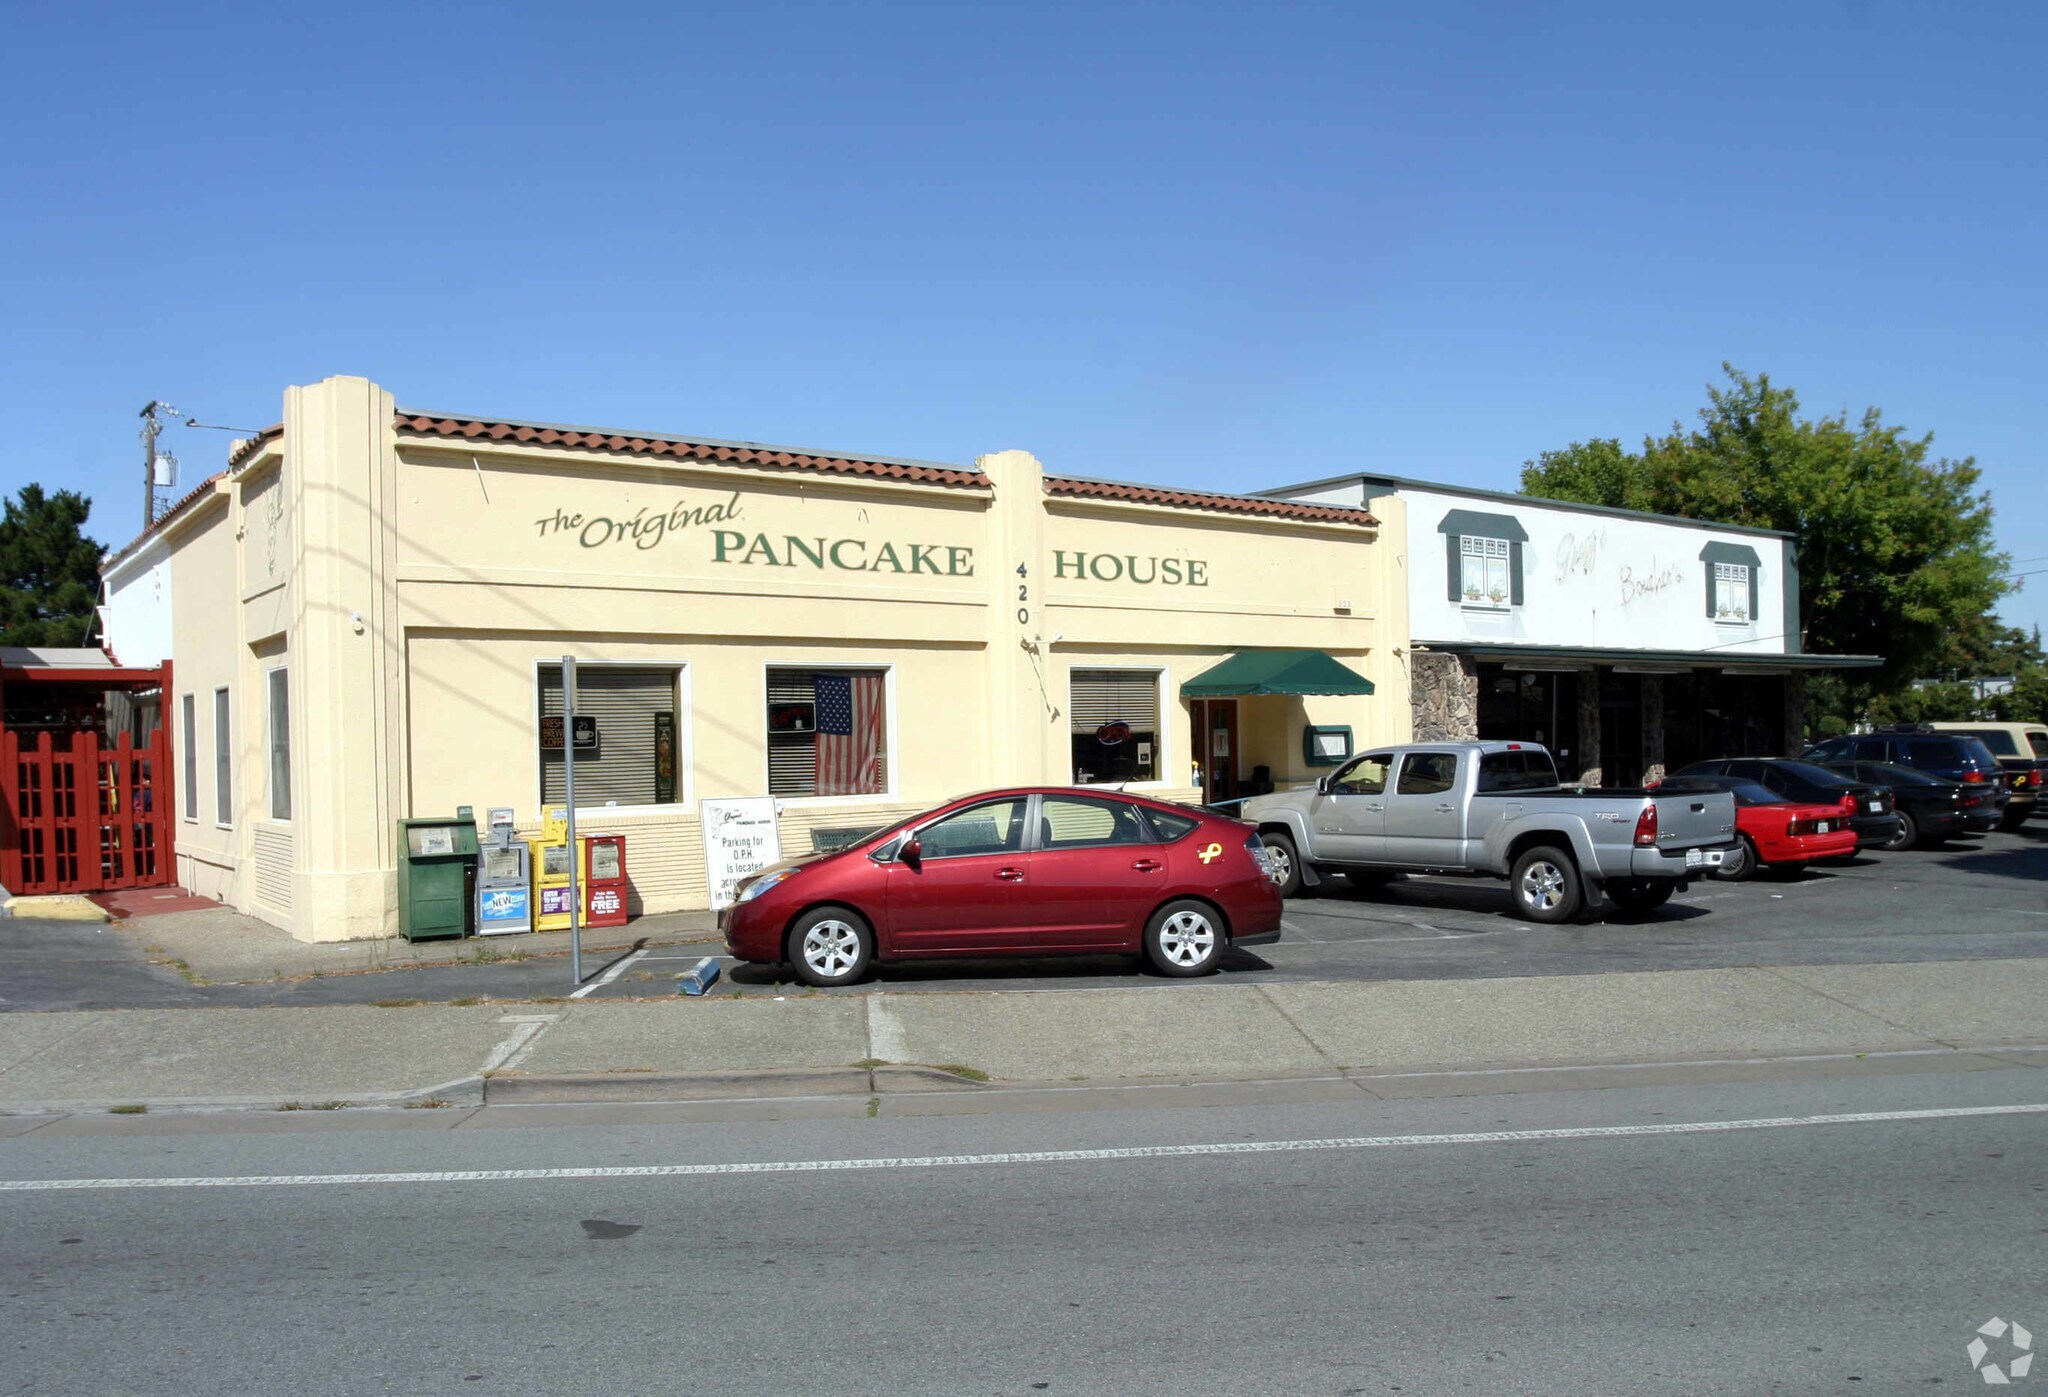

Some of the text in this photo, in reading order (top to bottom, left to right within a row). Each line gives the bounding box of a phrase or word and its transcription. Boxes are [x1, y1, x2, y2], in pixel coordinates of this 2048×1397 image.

[535, 492, 743, 550] The Original
[710, 529, 1209, 587] PANCAKE HOUSE
[722, 836, 764, 848] Parking for
[733, 849, 755, 860] O.P.H.
[726, 863, 733, 873] is
[715, 890, 723, 901] in
[492, 895, 512, 908] NEW
[591, 899, 620, 910] FREE
